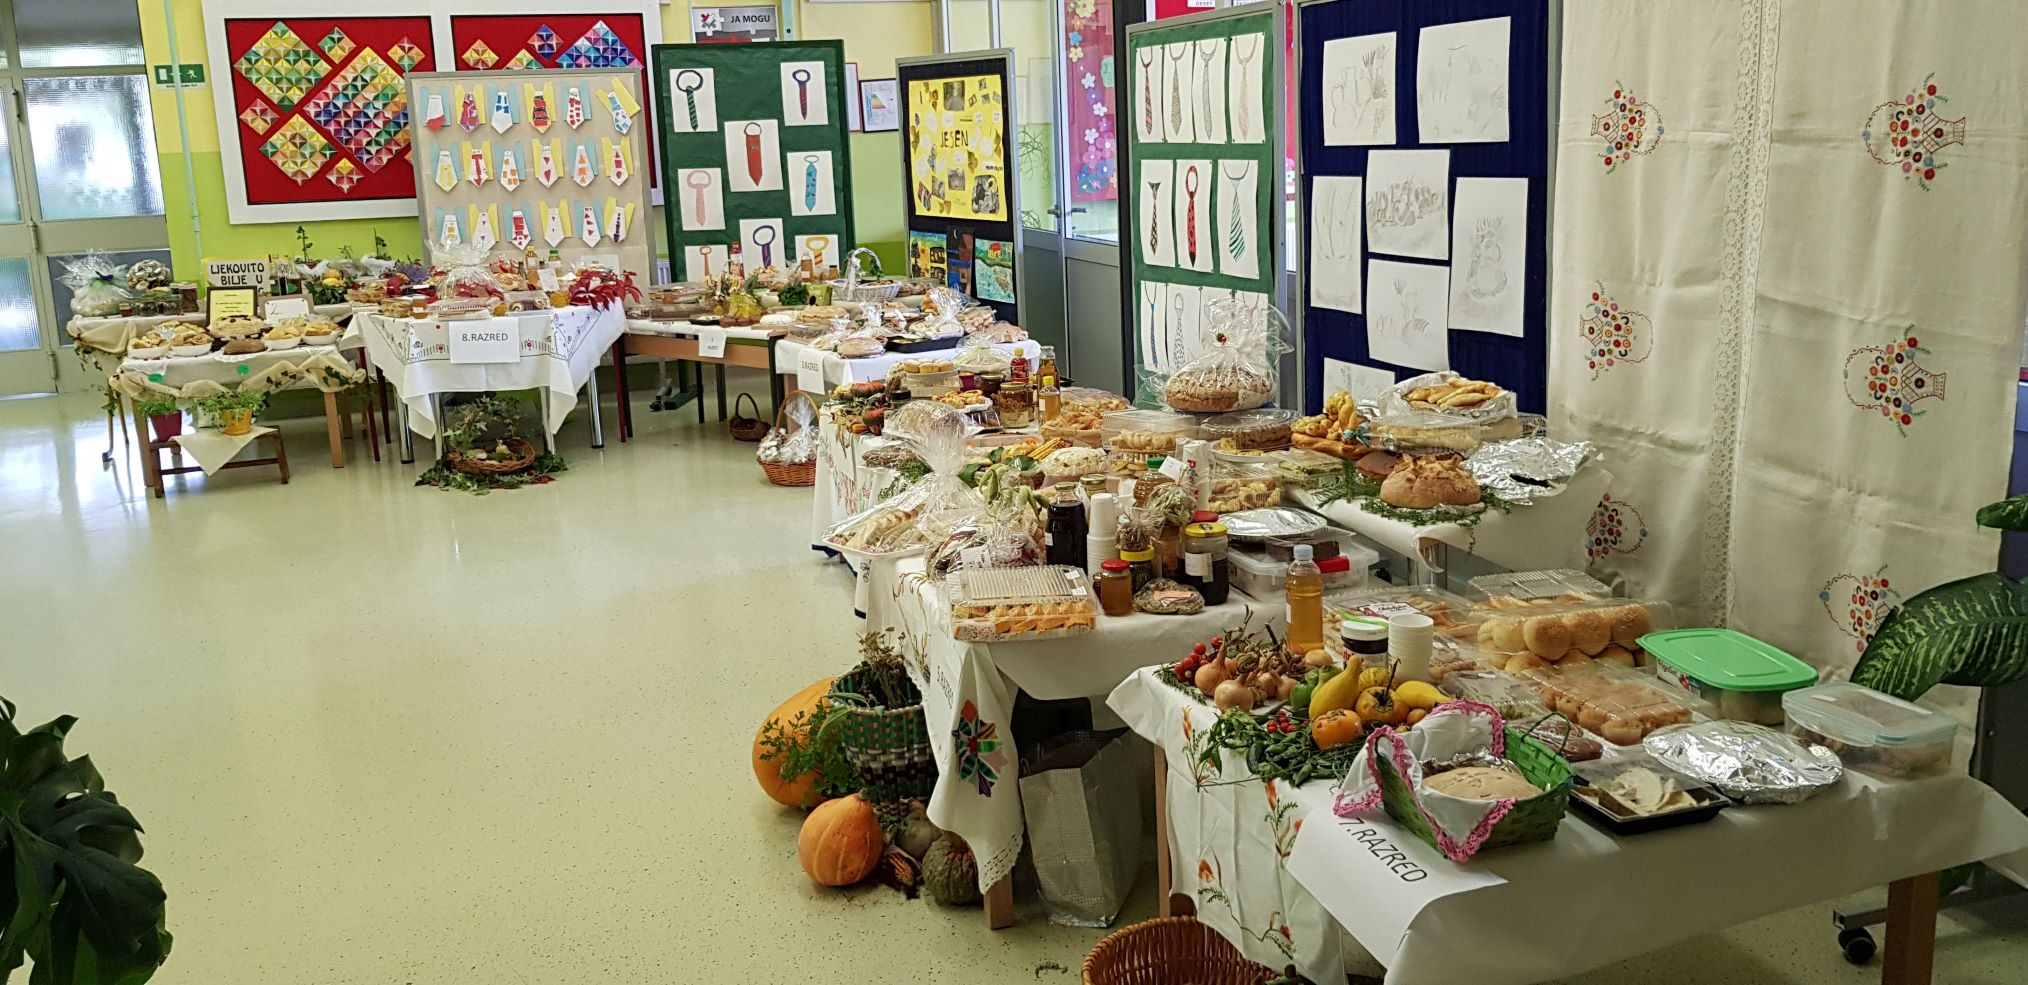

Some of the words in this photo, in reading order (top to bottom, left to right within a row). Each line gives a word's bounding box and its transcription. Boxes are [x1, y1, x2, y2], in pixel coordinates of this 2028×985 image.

[730, 15, 741, 23] JA
[742, 14, 771, 23] MOGU
[940, 129, 969, 149] JESEN
[221, 274, 247, 285] BILJE
[255, 274, 263, 284] U
[461, 333, 509, 342] 8.RAZRED
[1338, 817, 1428, 882] 7.RAZRED
